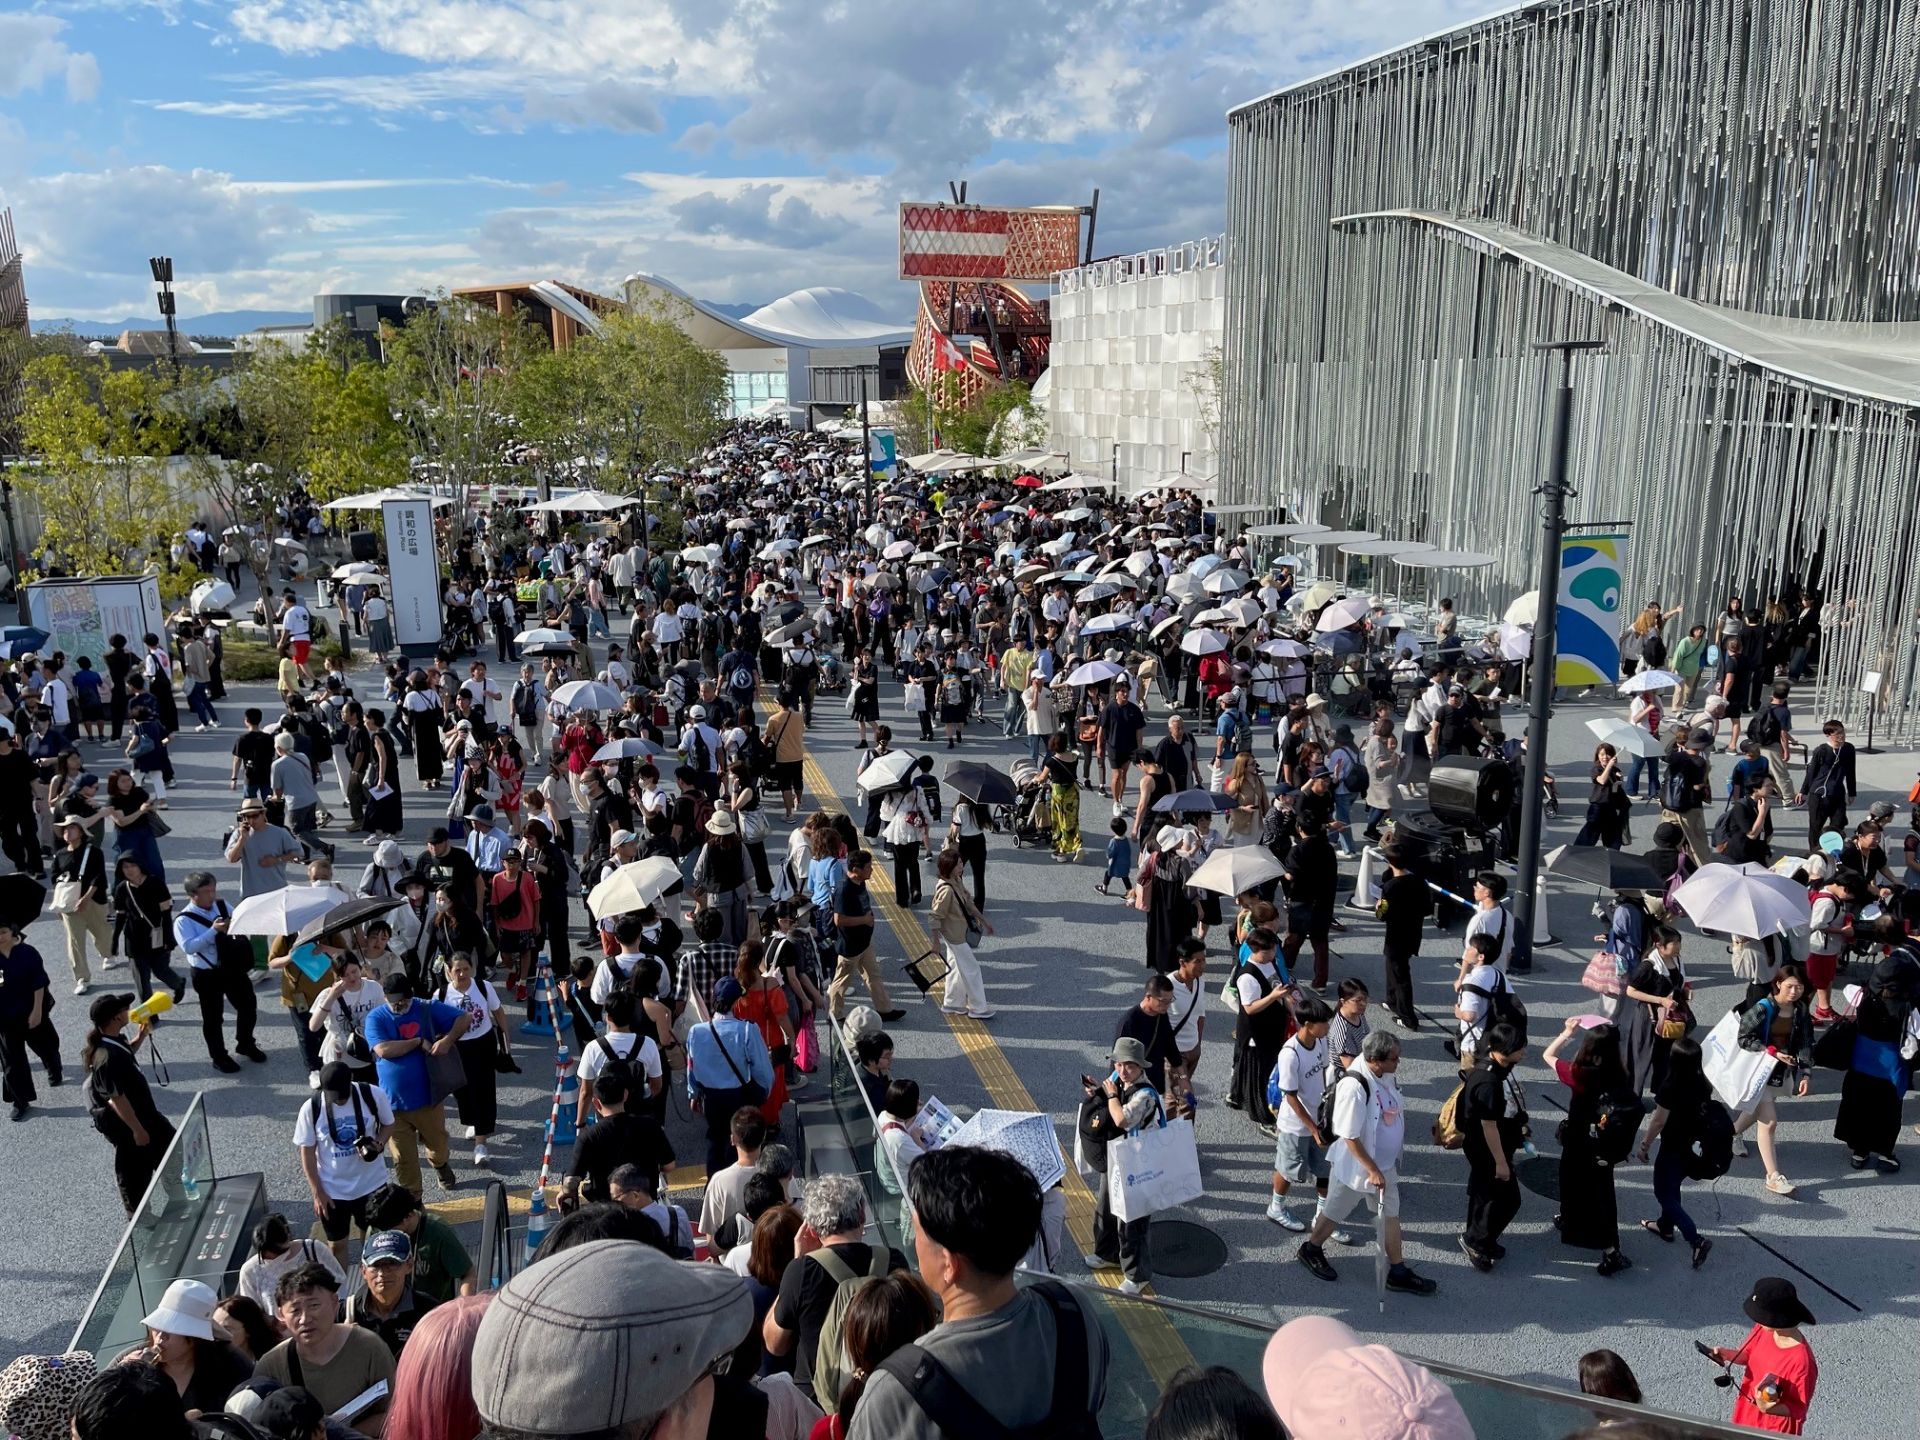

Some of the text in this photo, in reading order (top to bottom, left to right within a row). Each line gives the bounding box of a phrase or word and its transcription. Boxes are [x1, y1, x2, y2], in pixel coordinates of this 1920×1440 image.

[405, 510, 418, 556] 調和の広場
